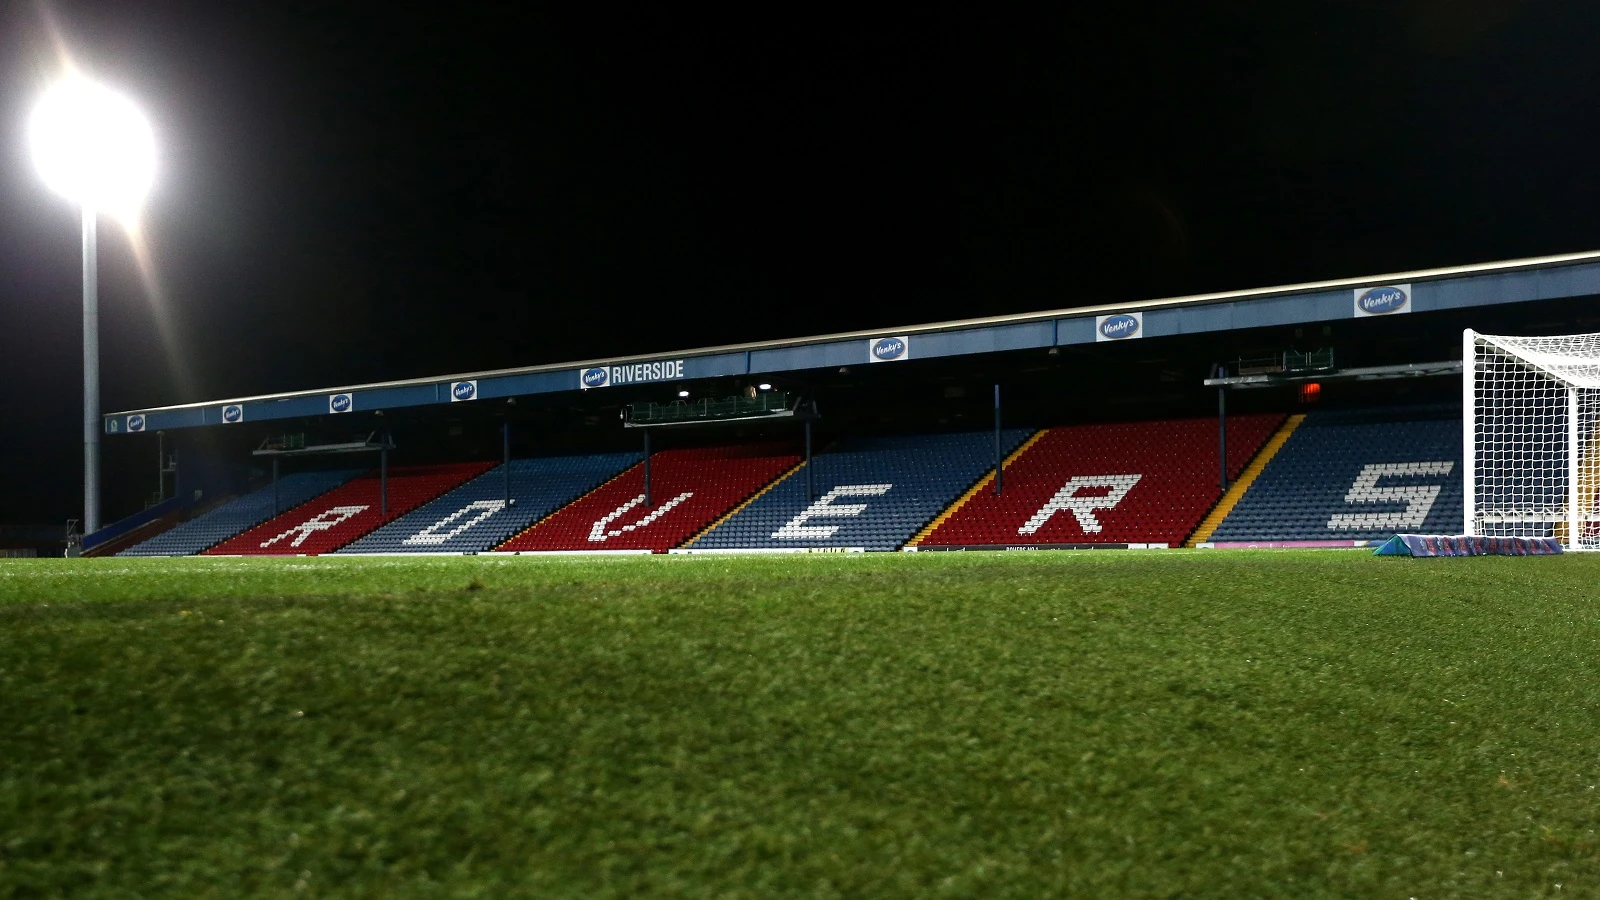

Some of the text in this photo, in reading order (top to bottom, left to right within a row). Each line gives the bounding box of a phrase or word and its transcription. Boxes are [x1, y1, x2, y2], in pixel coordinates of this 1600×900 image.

[1363, 291, 1401, 309] Venky's
[1104, 319, 1135, 334] Venky's
[876, 342, 902, 355] Venky's
[585, 371, 605, 383] Venky's
[612, 360, 684, 384] RIVERSIDE
